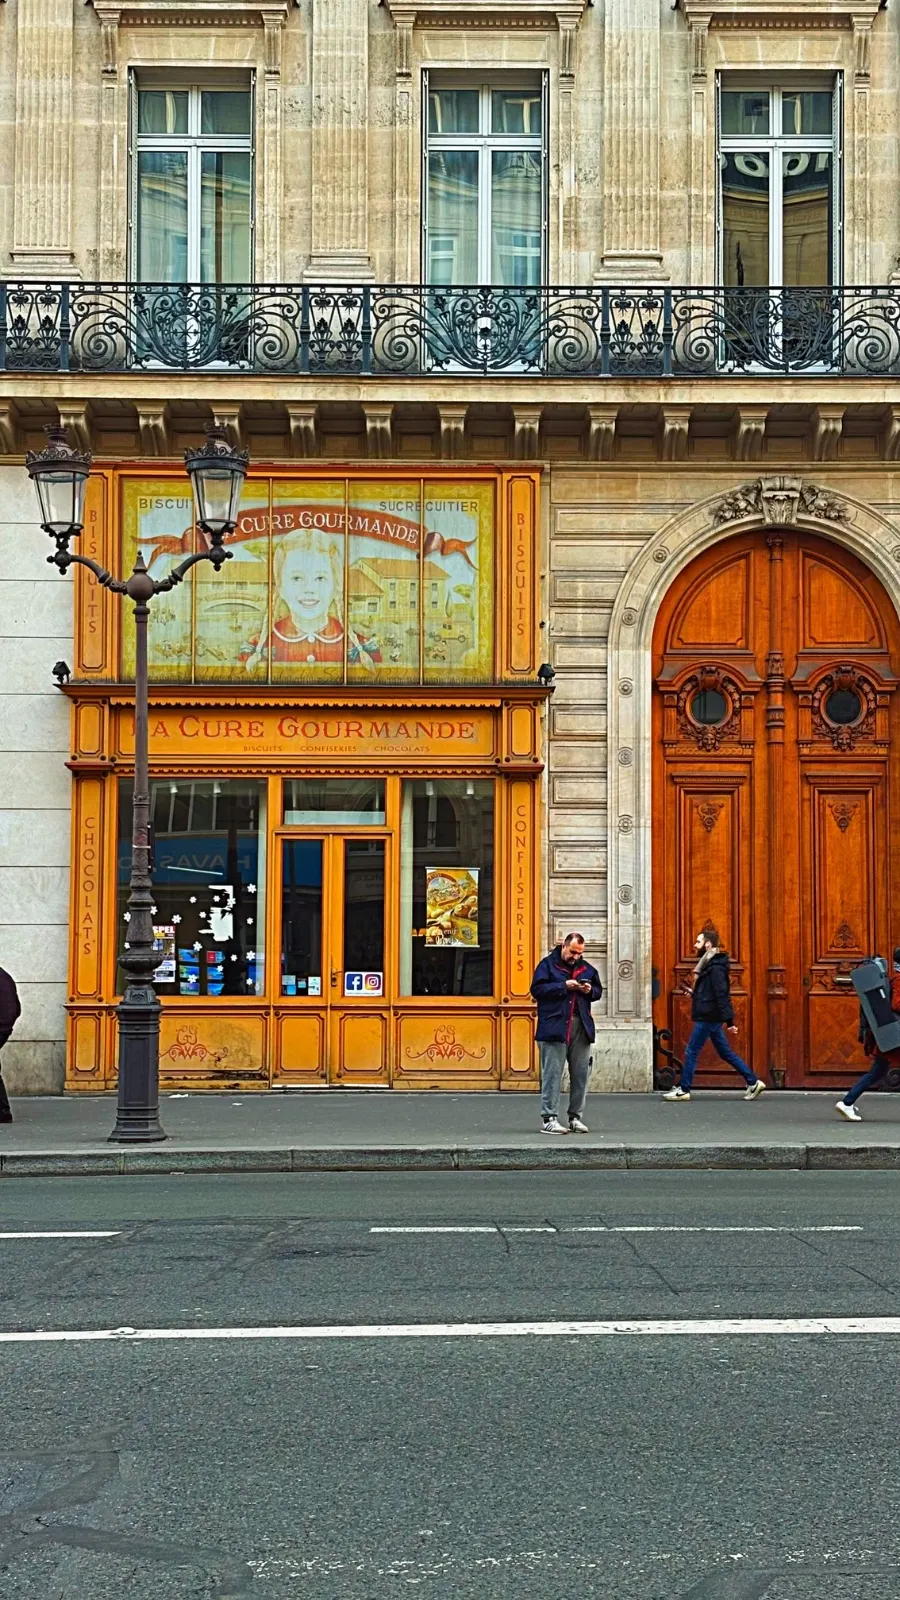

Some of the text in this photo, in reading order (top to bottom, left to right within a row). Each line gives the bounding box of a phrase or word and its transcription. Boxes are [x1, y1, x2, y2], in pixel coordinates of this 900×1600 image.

[139, 498, 193, 509] BISCUI
[240, 510, 419, 544] CURE GOURMANDE
[87, 509, 98, 634] BISUITS
[515, 512, 526, 636] BISCUITS
[178, 714, 265, 738] CURE
[277, 715, 475, 739] GOURMANDE
[82, 816, 95, 955] CHOCOLATS
[515, 804, 527, 972] CONFISERIES
